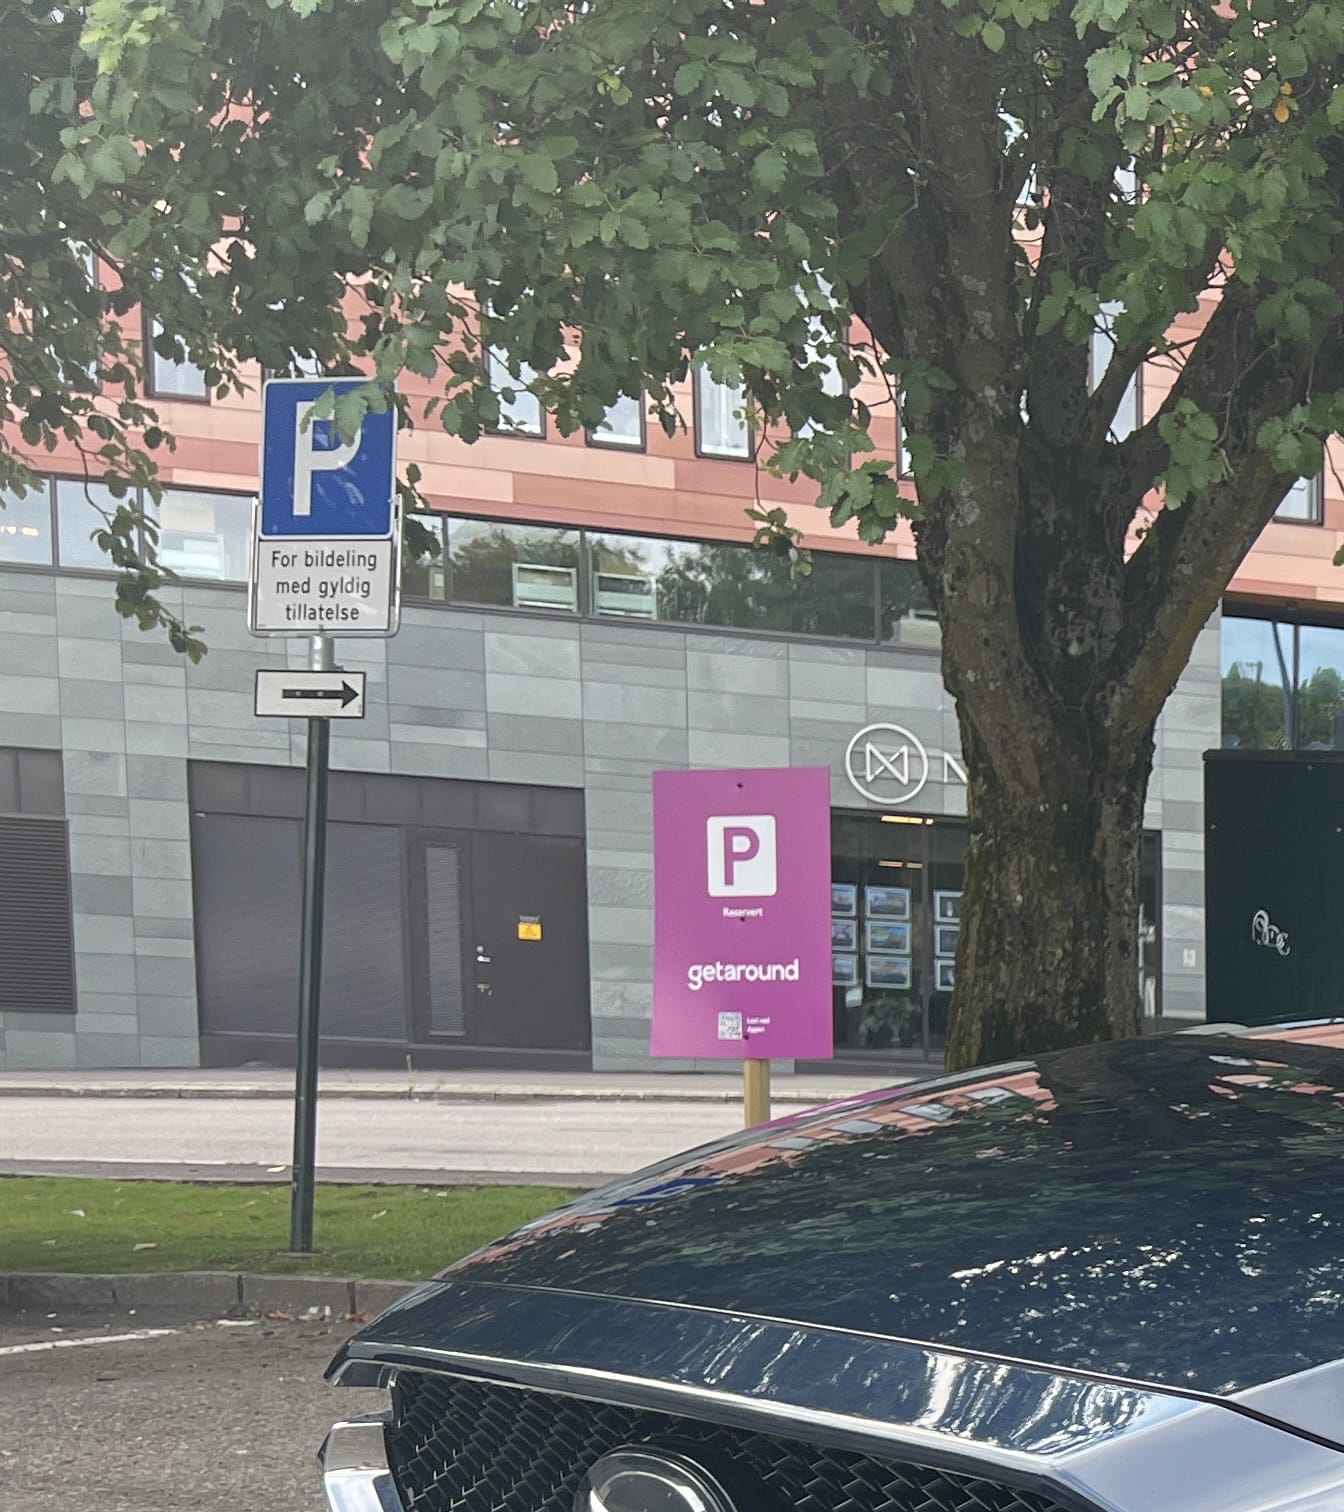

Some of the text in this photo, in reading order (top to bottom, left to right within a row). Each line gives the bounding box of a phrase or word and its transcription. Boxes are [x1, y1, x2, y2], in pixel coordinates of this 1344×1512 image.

[293, 401, 361, 516] P
[271, 549, 377, 571] For bildeling
[276, 576, 371, 598] med gyldig
[285, 603, 360, 621] tillatelse
[722, 826, 760, 886] P
[687, 958, 800, 991] getaround
